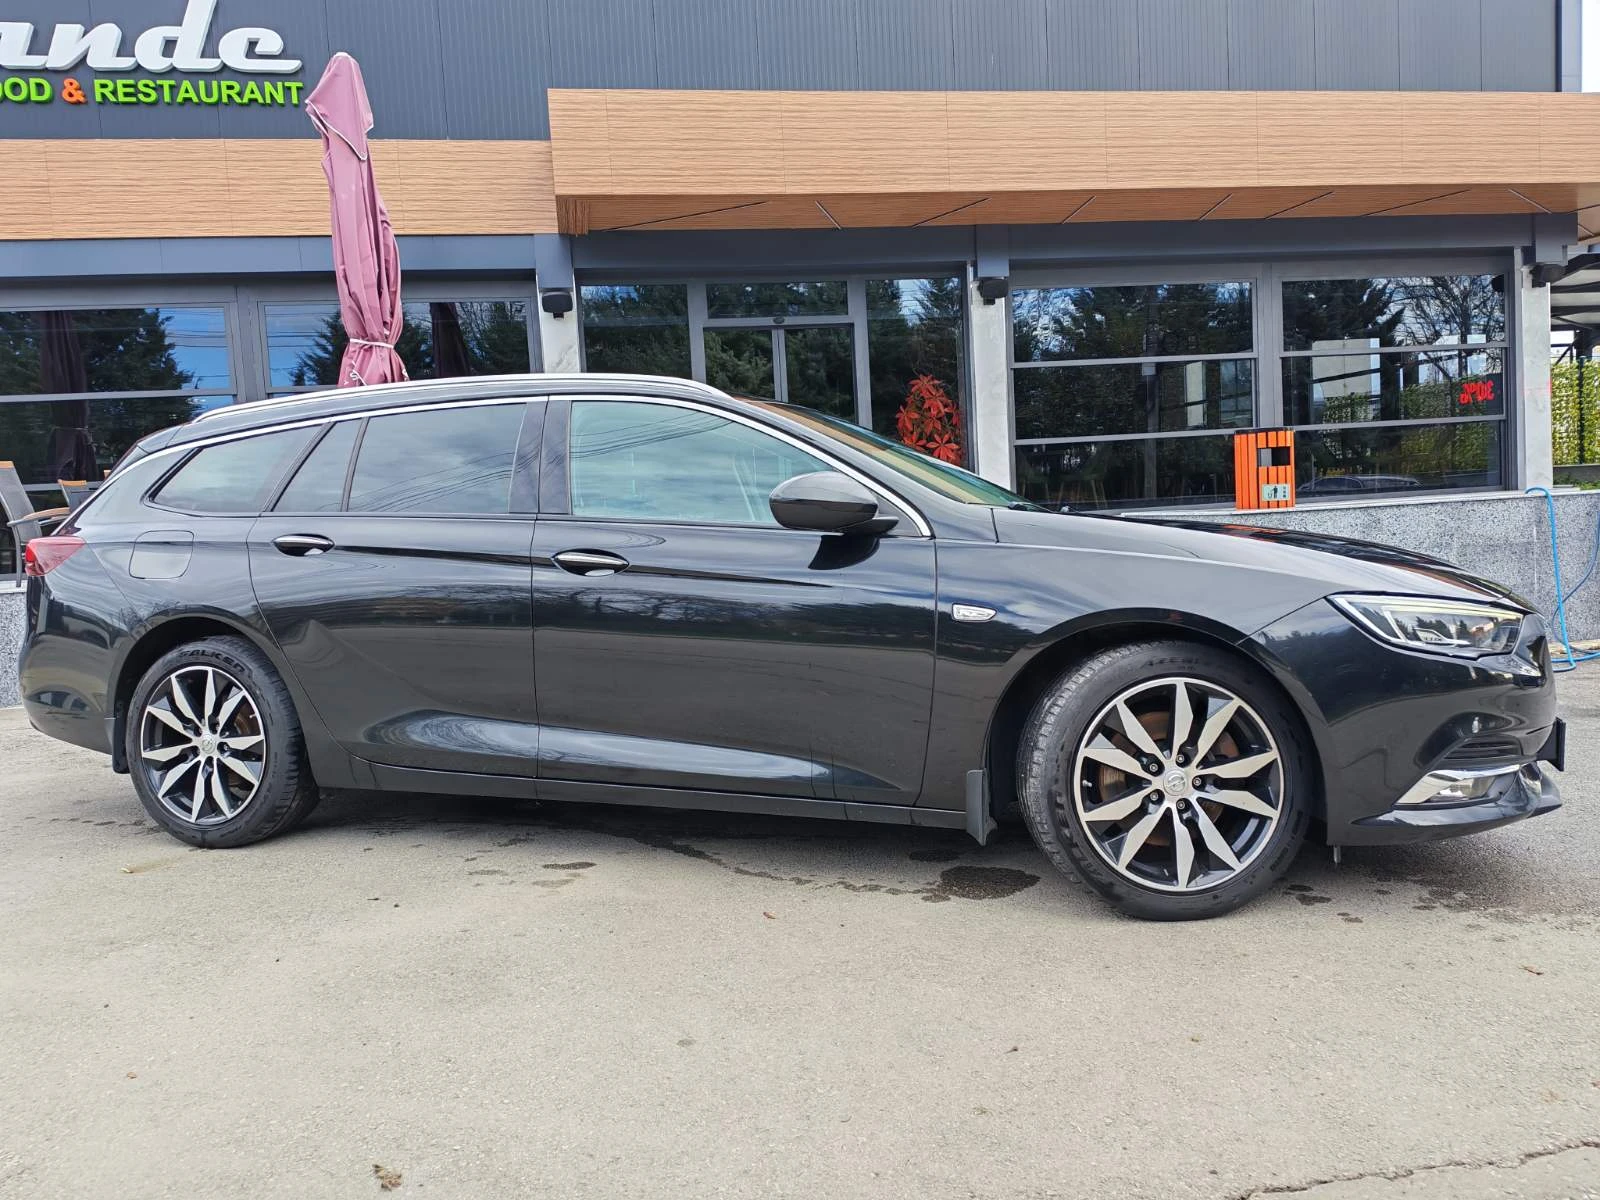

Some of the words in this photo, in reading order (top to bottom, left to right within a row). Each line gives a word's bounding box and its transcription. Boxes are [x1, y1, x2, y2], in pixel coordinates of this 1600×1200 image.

[0, 76, 53, 103] OD
[62, 77, 87, 104] &
[93, 79, 303, 107] RESTAURANT
